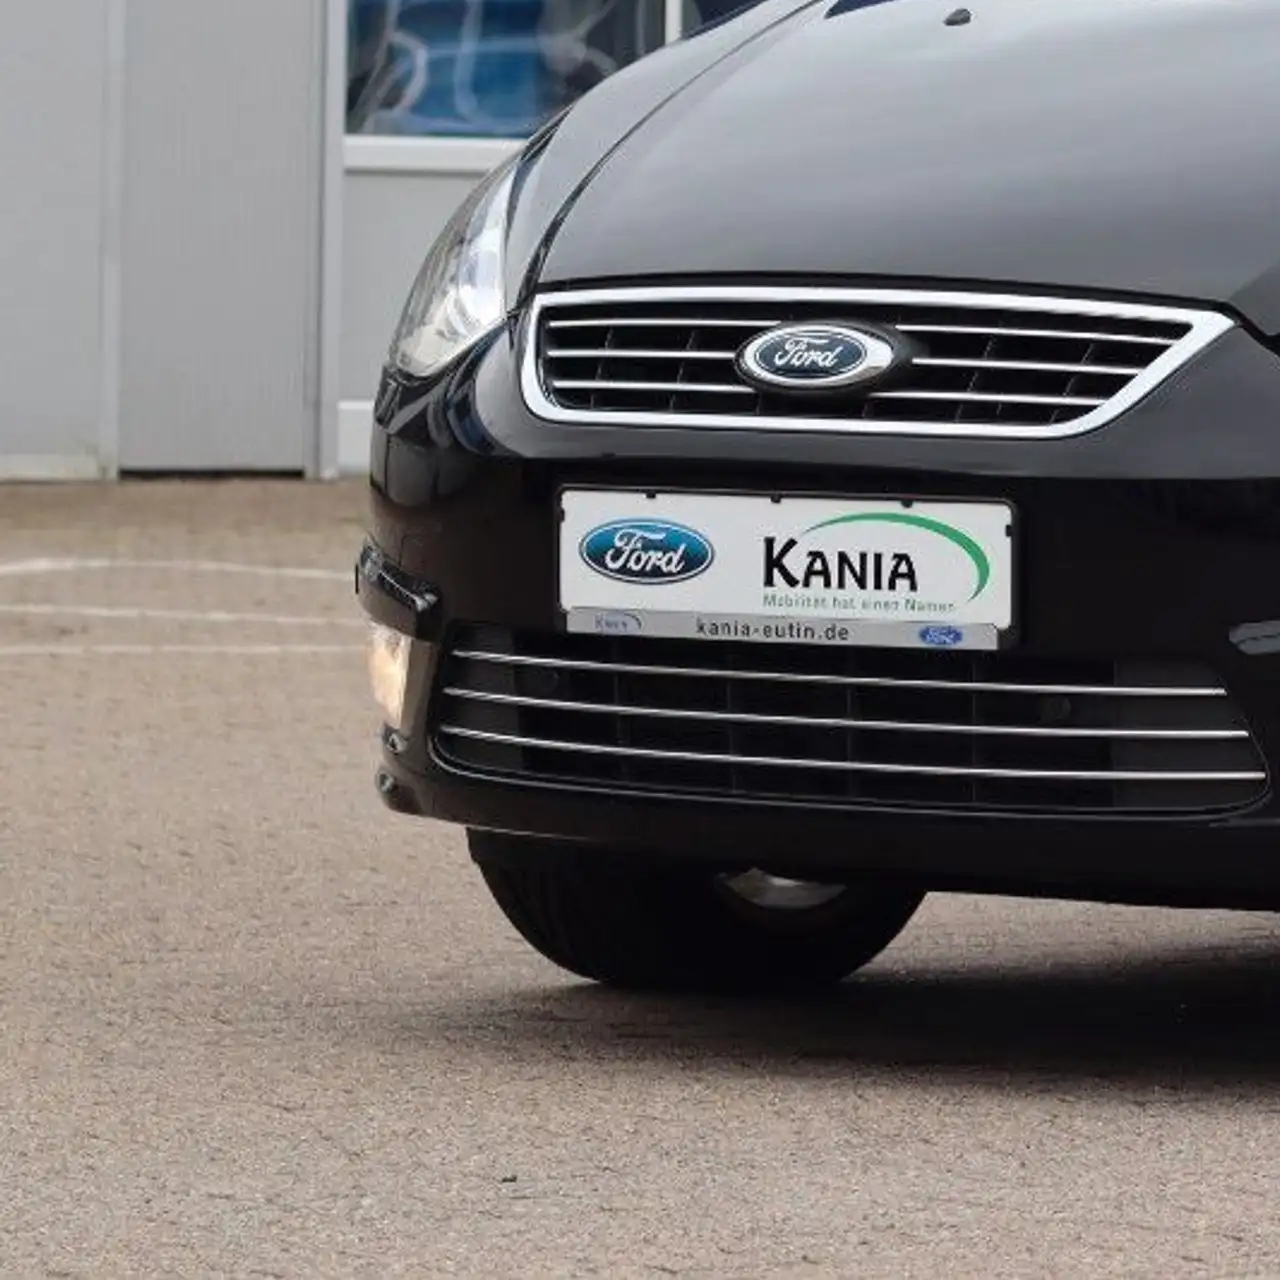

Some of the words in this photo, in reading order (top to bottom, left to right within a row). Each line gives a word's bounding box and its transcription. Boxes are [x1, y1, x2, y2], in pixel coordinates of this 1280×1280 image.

[774, 339, 844, 367] Ford
[604, 528, 686, 573] Ford
[763, 537, 918, 592] KANIA
[696, 617, 850, 641] kania-eutin.de
